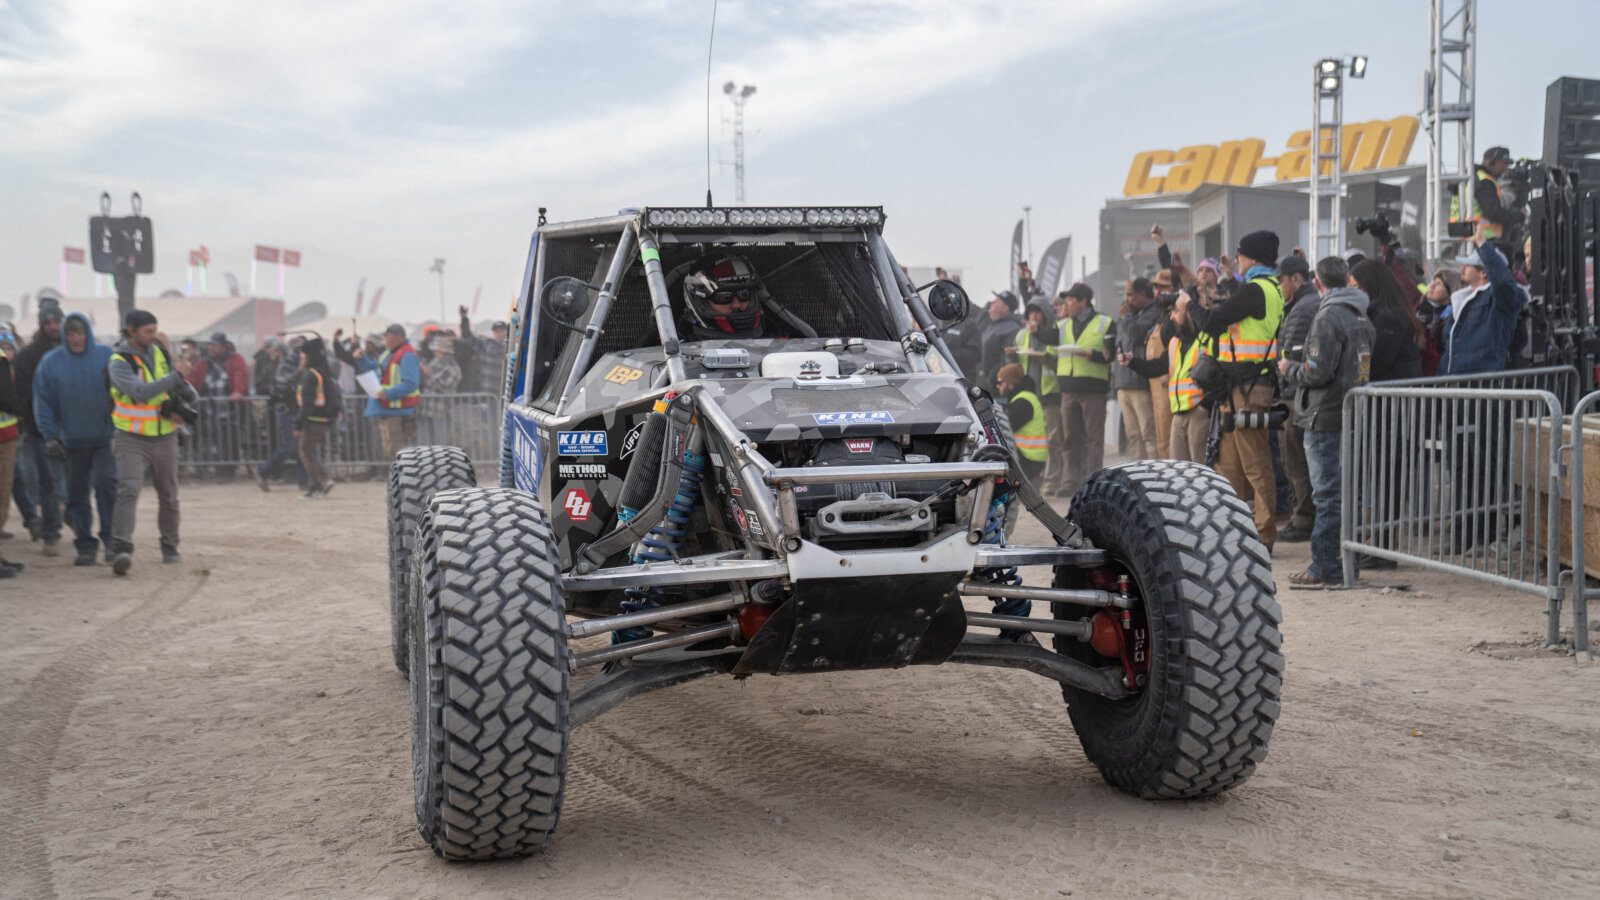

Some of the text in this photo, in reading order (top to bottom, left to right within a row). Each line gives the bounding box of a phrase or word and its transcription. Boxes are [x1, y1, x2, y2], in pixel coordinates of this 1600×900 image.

[1123, 115, 1421, 196] can-am
[818, 412, 887, 420] KING
[559, 433, 605, 444] KING
[625, 430, 640, 451] UFO
[849, 442, 871, 450] WARN
[515, 426, 537, 481] KING
[559, 464, 606, 474] METHOD
